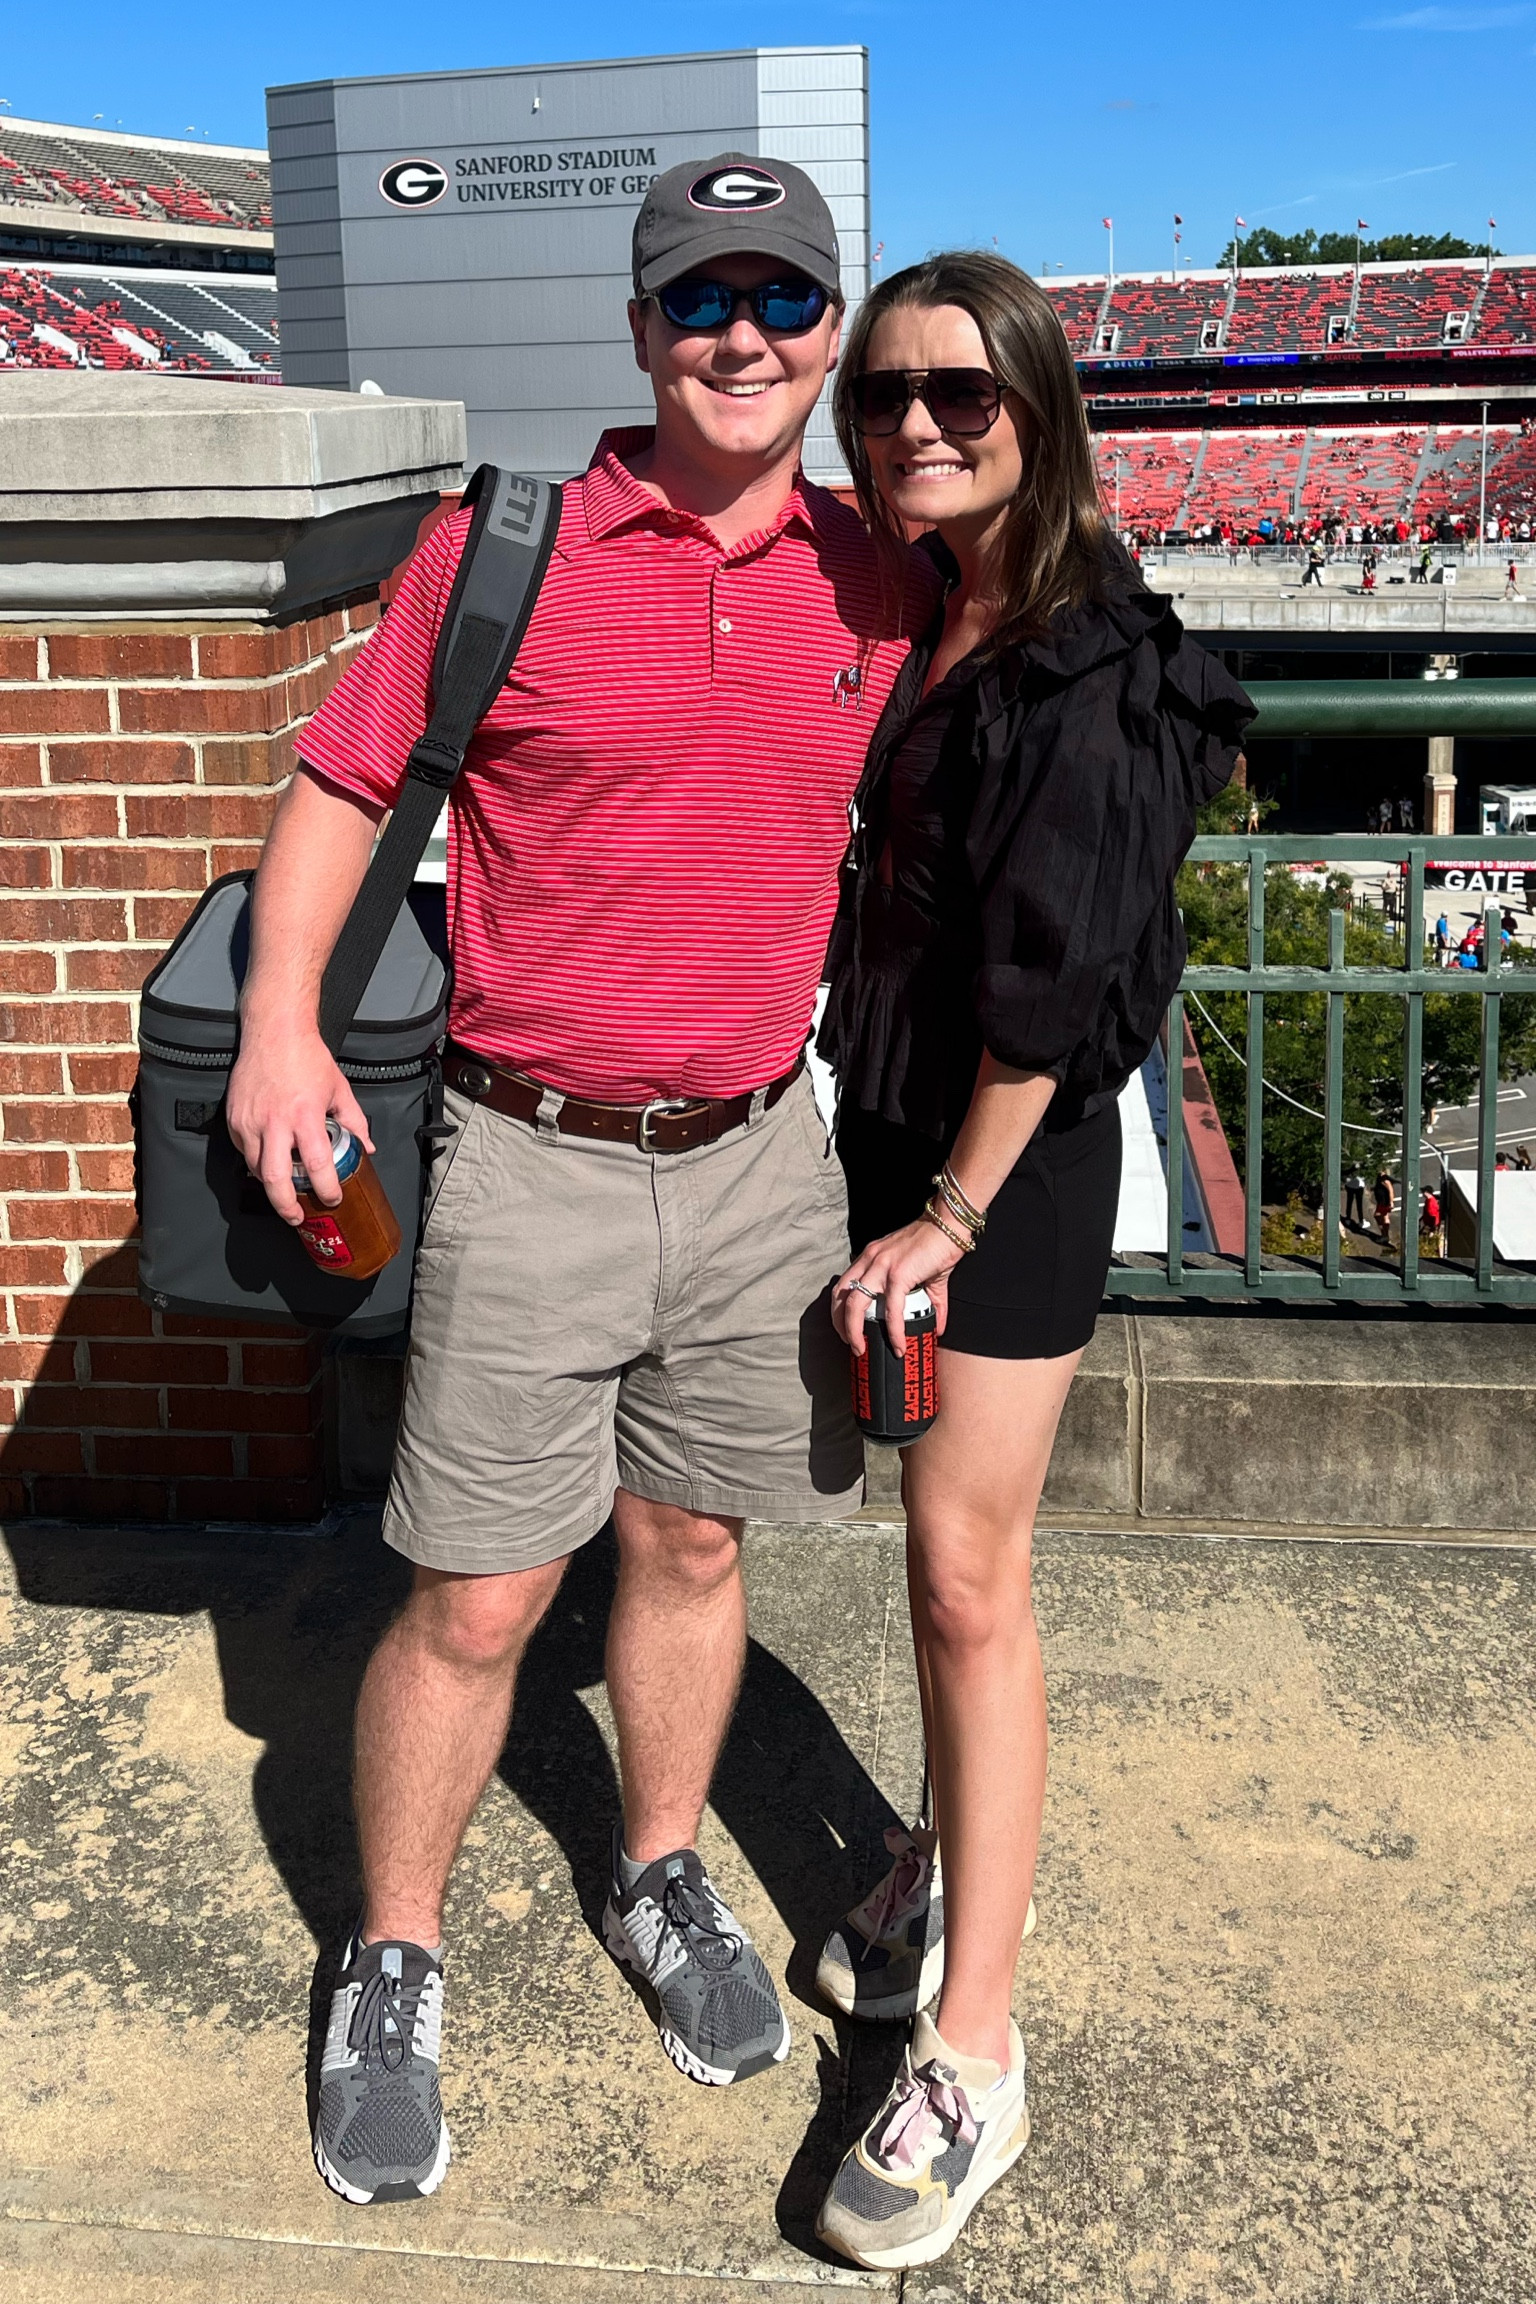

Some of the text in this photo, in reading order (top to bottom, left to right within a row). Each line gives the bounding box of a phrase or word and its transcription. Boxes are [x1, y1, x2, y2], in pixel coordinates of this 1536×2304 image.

[455, 147, 657, 177] SANFORD STADIUM
[456, 178, 585, 203] UNIVERSITY
[588, 176, 617, 196] OF
[1113, 360, 1146, 368] DELTA
[1452, 348, 1502, 357] VOLLEYBALL
[500, 474, 539, 535] ETI
[1433, 861, 1481, 869] Welcome
[1483, 861, 1494, 869] to
[1444, 869, 1526, 893] GATE
[904, 1335, 920, 1422] ZACH BRYAN
[922, 1332, 934, 1419] ZACH BRYAN
